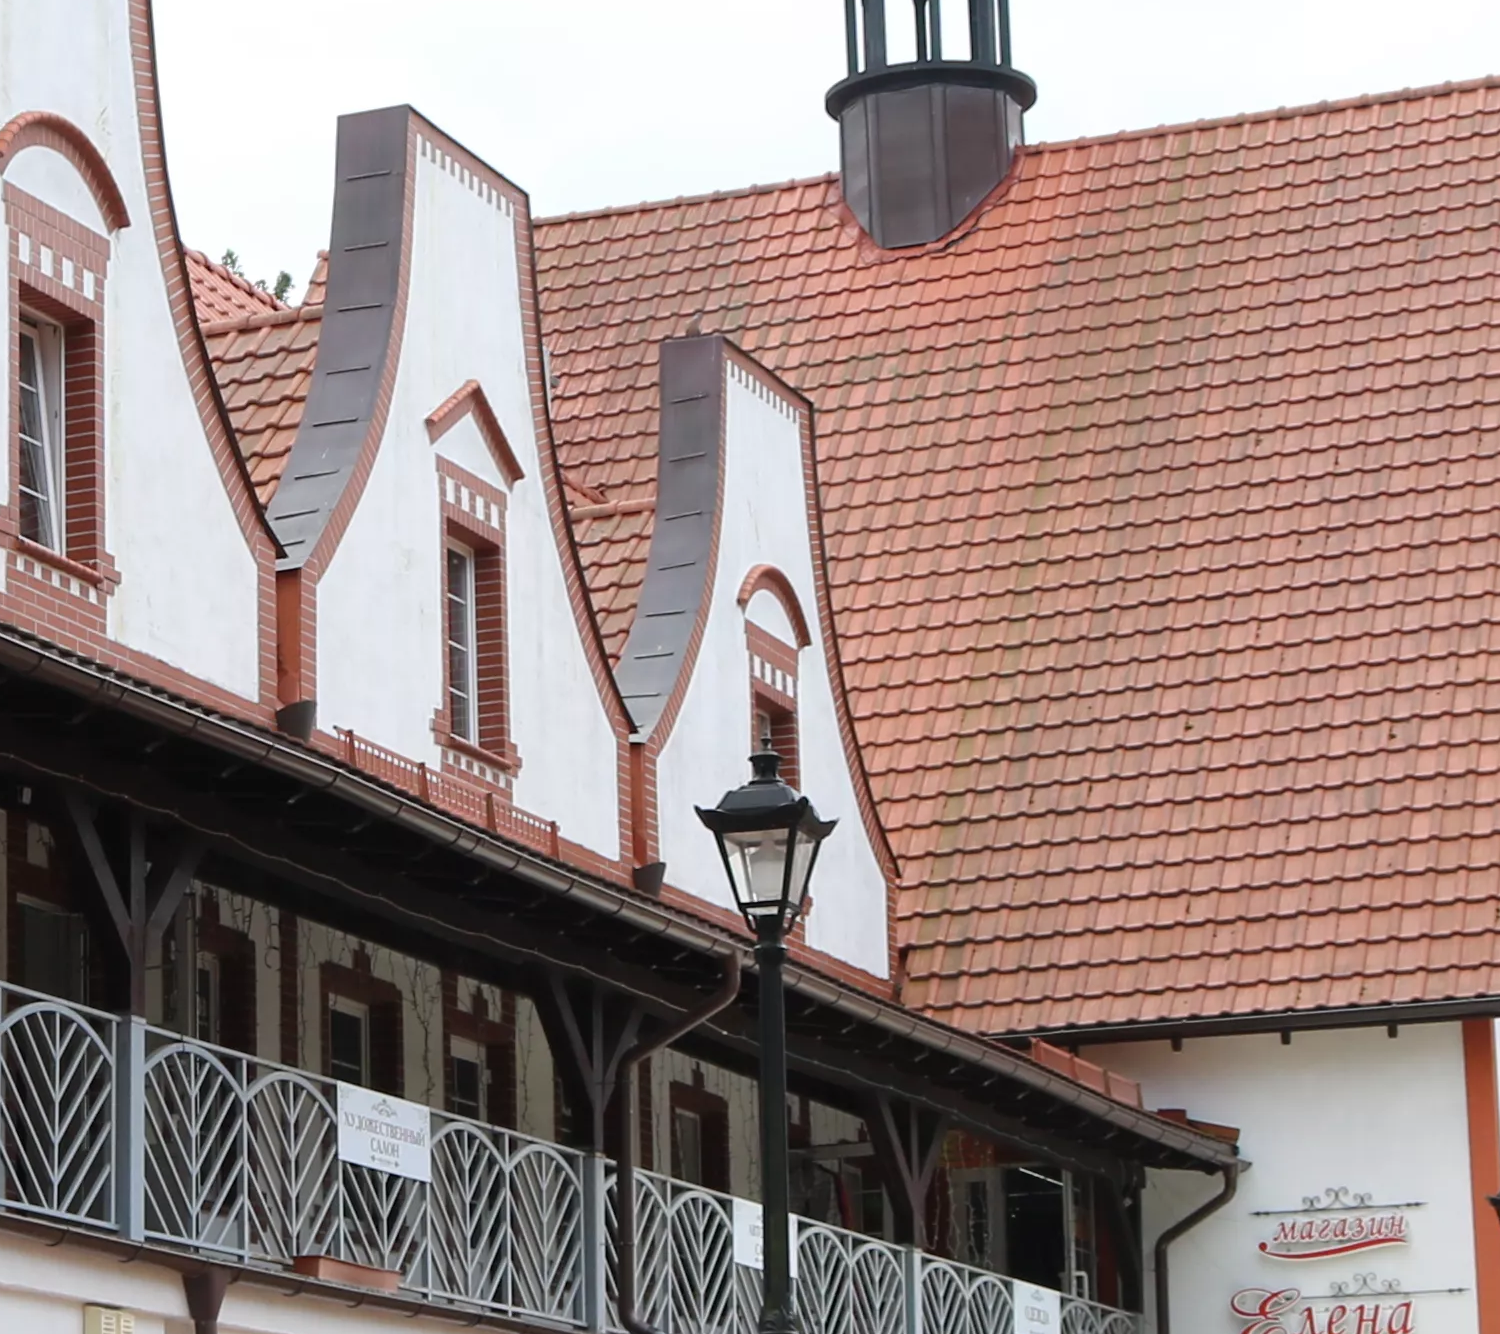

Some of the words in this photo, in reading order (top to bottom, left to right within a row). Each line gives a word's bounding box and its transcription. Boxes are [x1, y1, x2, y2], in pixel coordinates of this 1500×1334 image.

[343, 1111, 426, 1147] ХУДОЖЕСТВЕННЫЙ
[370, 1137, 400, 1158] САЛОН
[1272, 1214, 1407, 1243] магазин
